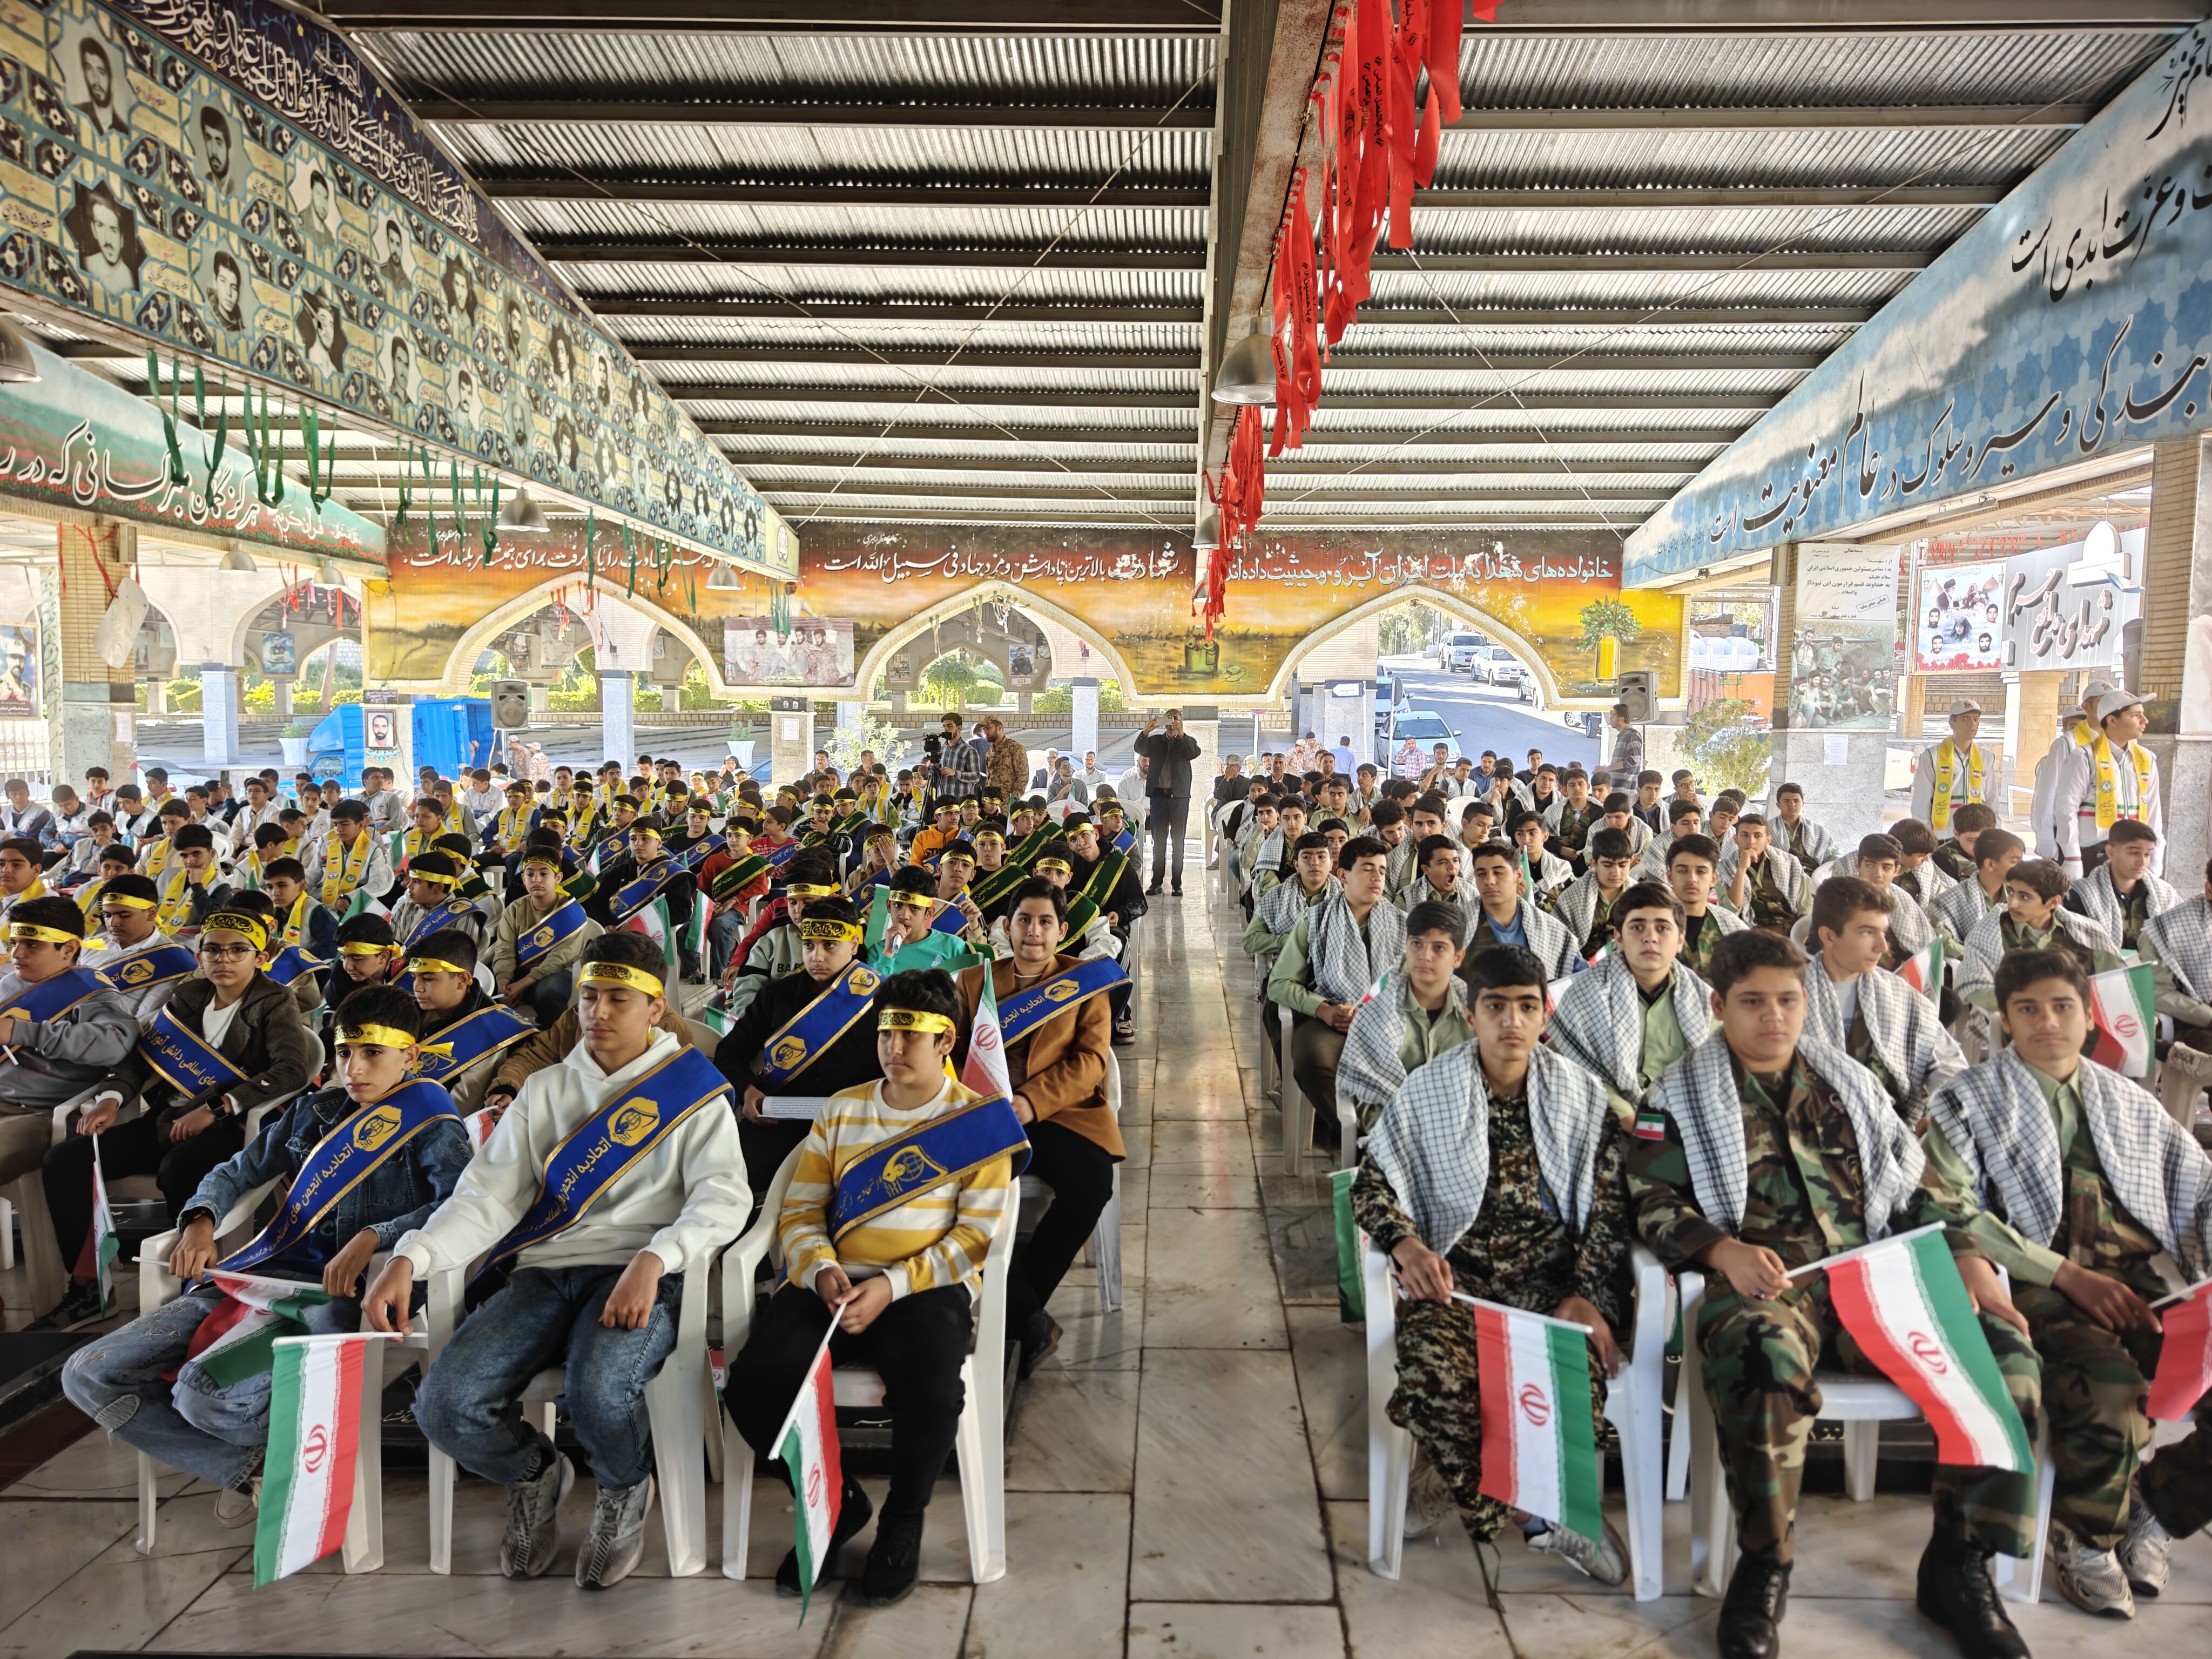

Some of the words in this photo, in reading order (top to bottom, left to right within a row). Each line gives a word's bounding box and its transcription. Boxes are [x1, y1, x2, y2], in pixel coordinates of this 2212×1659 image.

[321, 1142, 354, 1178] اتحادیه
[577, 1136, 612, 1174] اتحادیه
[302, 1172, 322, 1206] انجمن
